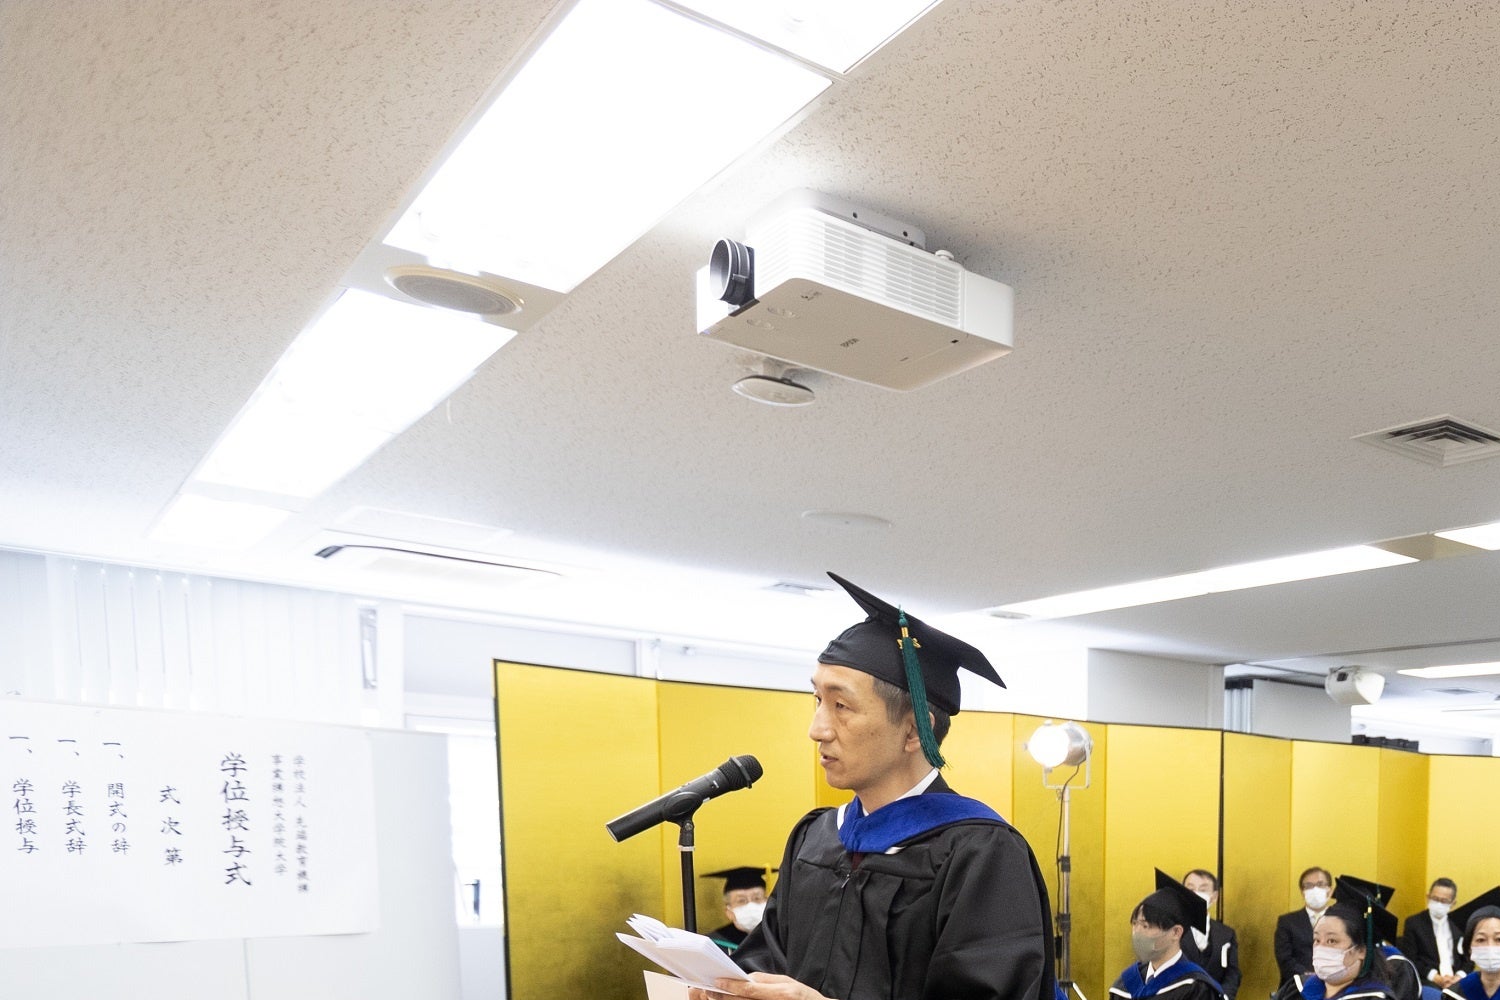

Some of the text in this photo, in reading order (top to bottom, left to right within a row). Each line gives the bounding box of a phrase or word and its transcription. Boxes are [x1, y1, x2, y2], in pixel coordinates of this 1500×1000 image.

[12, 777, 40, 855] 学位授与
[61, 779, 89, 856] 学長式辞
[106, 782, 132, 856] 開式の辞
[158, 784, 184, 867] 式次第
[219, 751, 254, 887] 学位授与式
